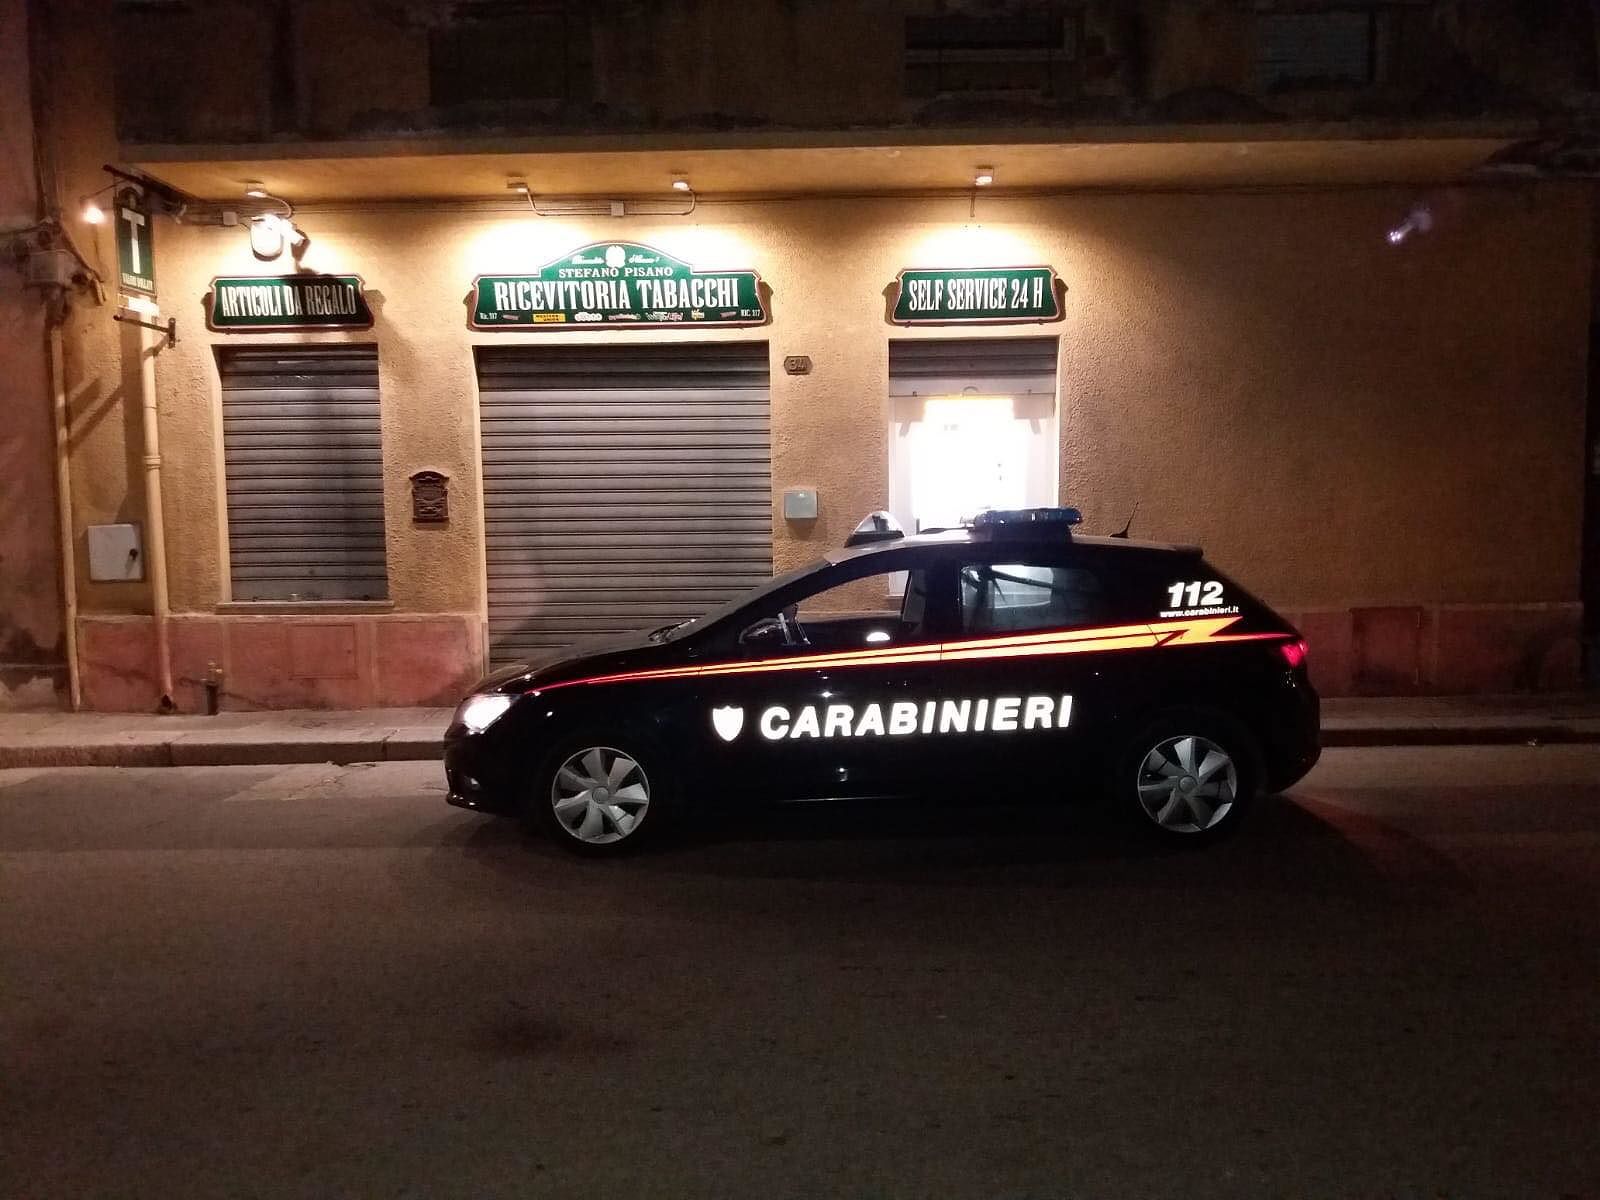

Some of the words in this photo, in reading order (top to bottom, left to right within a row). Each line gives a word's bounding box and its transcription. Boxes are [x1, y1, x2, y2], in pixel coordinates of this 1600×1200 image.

[122, 207, 145, 275] T
[559, 267, 619, 279] STEFANO
[624, 266, 673, 277] PISANO
[221, 285, 283, 317] ARTICOLI
[283, 285, 303, 316] DA
[305, 284, 357, 316] REGALO
[494, 279, 631, 311] RICEVITORIA
[636, 278, 739, 309] TABACCHI
[909, 279, 944, 311] SELF
[947, 277, 1007, 310] SERVICE
[1011, 278, 1029, 309] 24
[1033, 277, 1043, 308] H
[1168, 581, 1224, 608] 112
[1160, 606, 1239, 618] www.carabinieri.it
[760, 695, 1073, 740] CARABINIERI
